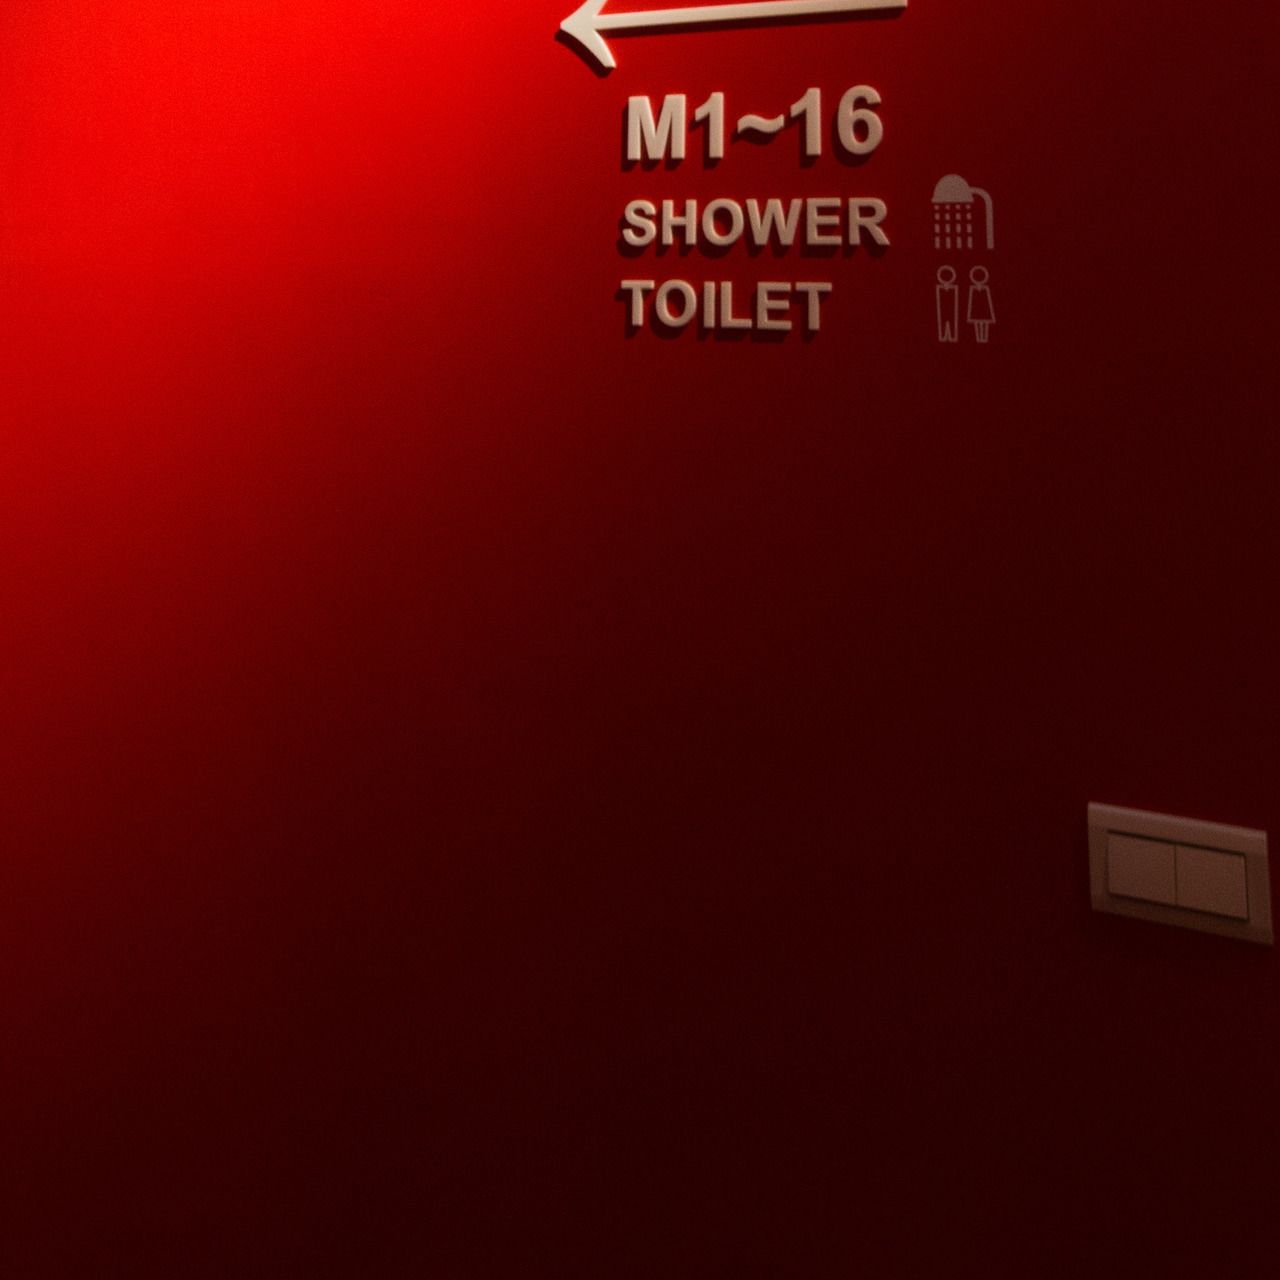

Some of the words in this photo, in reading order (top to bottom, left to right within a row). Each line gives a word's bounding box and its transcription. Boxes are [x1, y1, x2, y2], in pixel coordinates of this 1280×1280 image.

[626, 84, 884, 160] M1~16
[622, 198, 890, 247] SHOWER
[621, 280, 832, 331] TOILET
